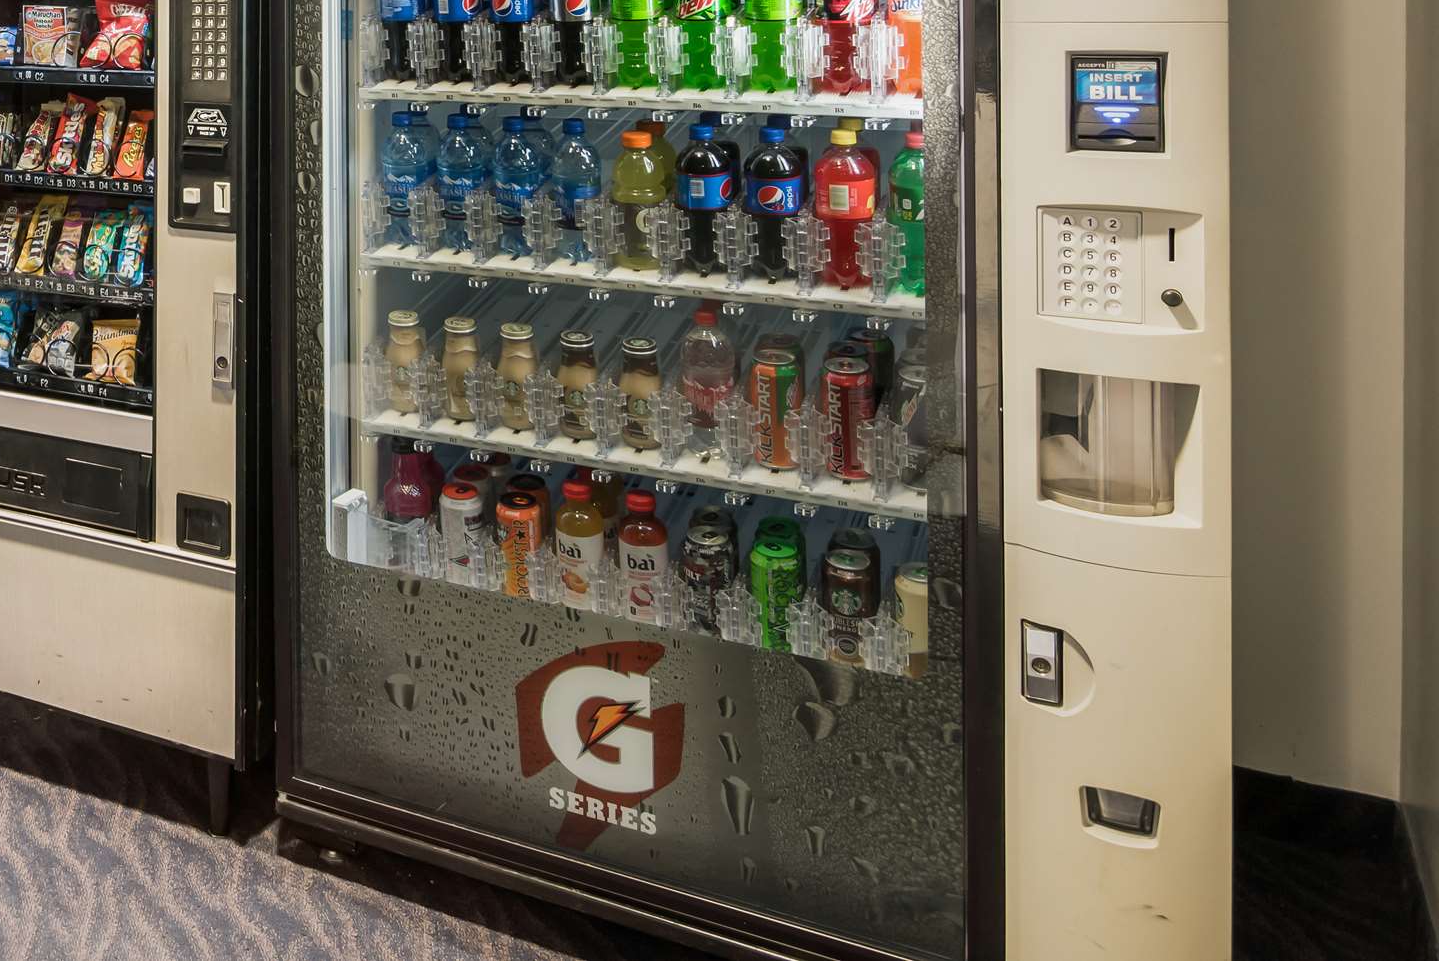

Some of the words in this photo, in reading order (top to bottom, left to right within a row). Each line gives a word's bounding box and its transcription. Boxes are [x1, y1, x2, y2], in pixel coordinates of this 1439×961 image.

[32, 11, 63, 20] Maruchan
[35, 73, 44, 81] C2
[100, 75, 109, 83] C4
[1090, 73, 1143, 82] INSERT
[1089, 85, 1143, 100] BILL
[5, 174, 13, 182] D1
[34, 176, 43, 185] D2
[67, 179, 76, 187] D3
[99, 181, 108, 190] D4
[133, 184, 143, 192] D5
[786, 186, 794, 208] pepsi
[1063, 217, 1072, 225] A
[1088, 218, 1092, 226] 1
[1110, 220, 1117, 228] 2
[1063, 233, 1071, 242] B
[1087, 234, 1093, 243] 3
[1110, 236, 1116, 245] 4
[1063, 249, 1071, 258] C
[1087, 251, 1093, 260] 5
[1110, 253, 1116, 261] 6
[1064, 266, 1072, 274] D
[1087, 267, 1093, 275] 7
[1110, 269, 1116, 277] 8
[35, 280, 43, 288] E2
[66, 283, 75, 292] E3
[100, 287, 109, 296] E4
[1064, 282, 1071, 290] E
[1087, 283, 1093, 292] 9
[1110, 286, 1116, 294] 0
[1064, 299, 1071, 307] F
[40, 378, 48, 387] F2
[99, 387, 107, 396] F4
[559, 539, 581, 559] bai
[627, 553, 655, 570] bai
[542, 665, 655, 793] G
[549, 786, 657, 836] SERIES
